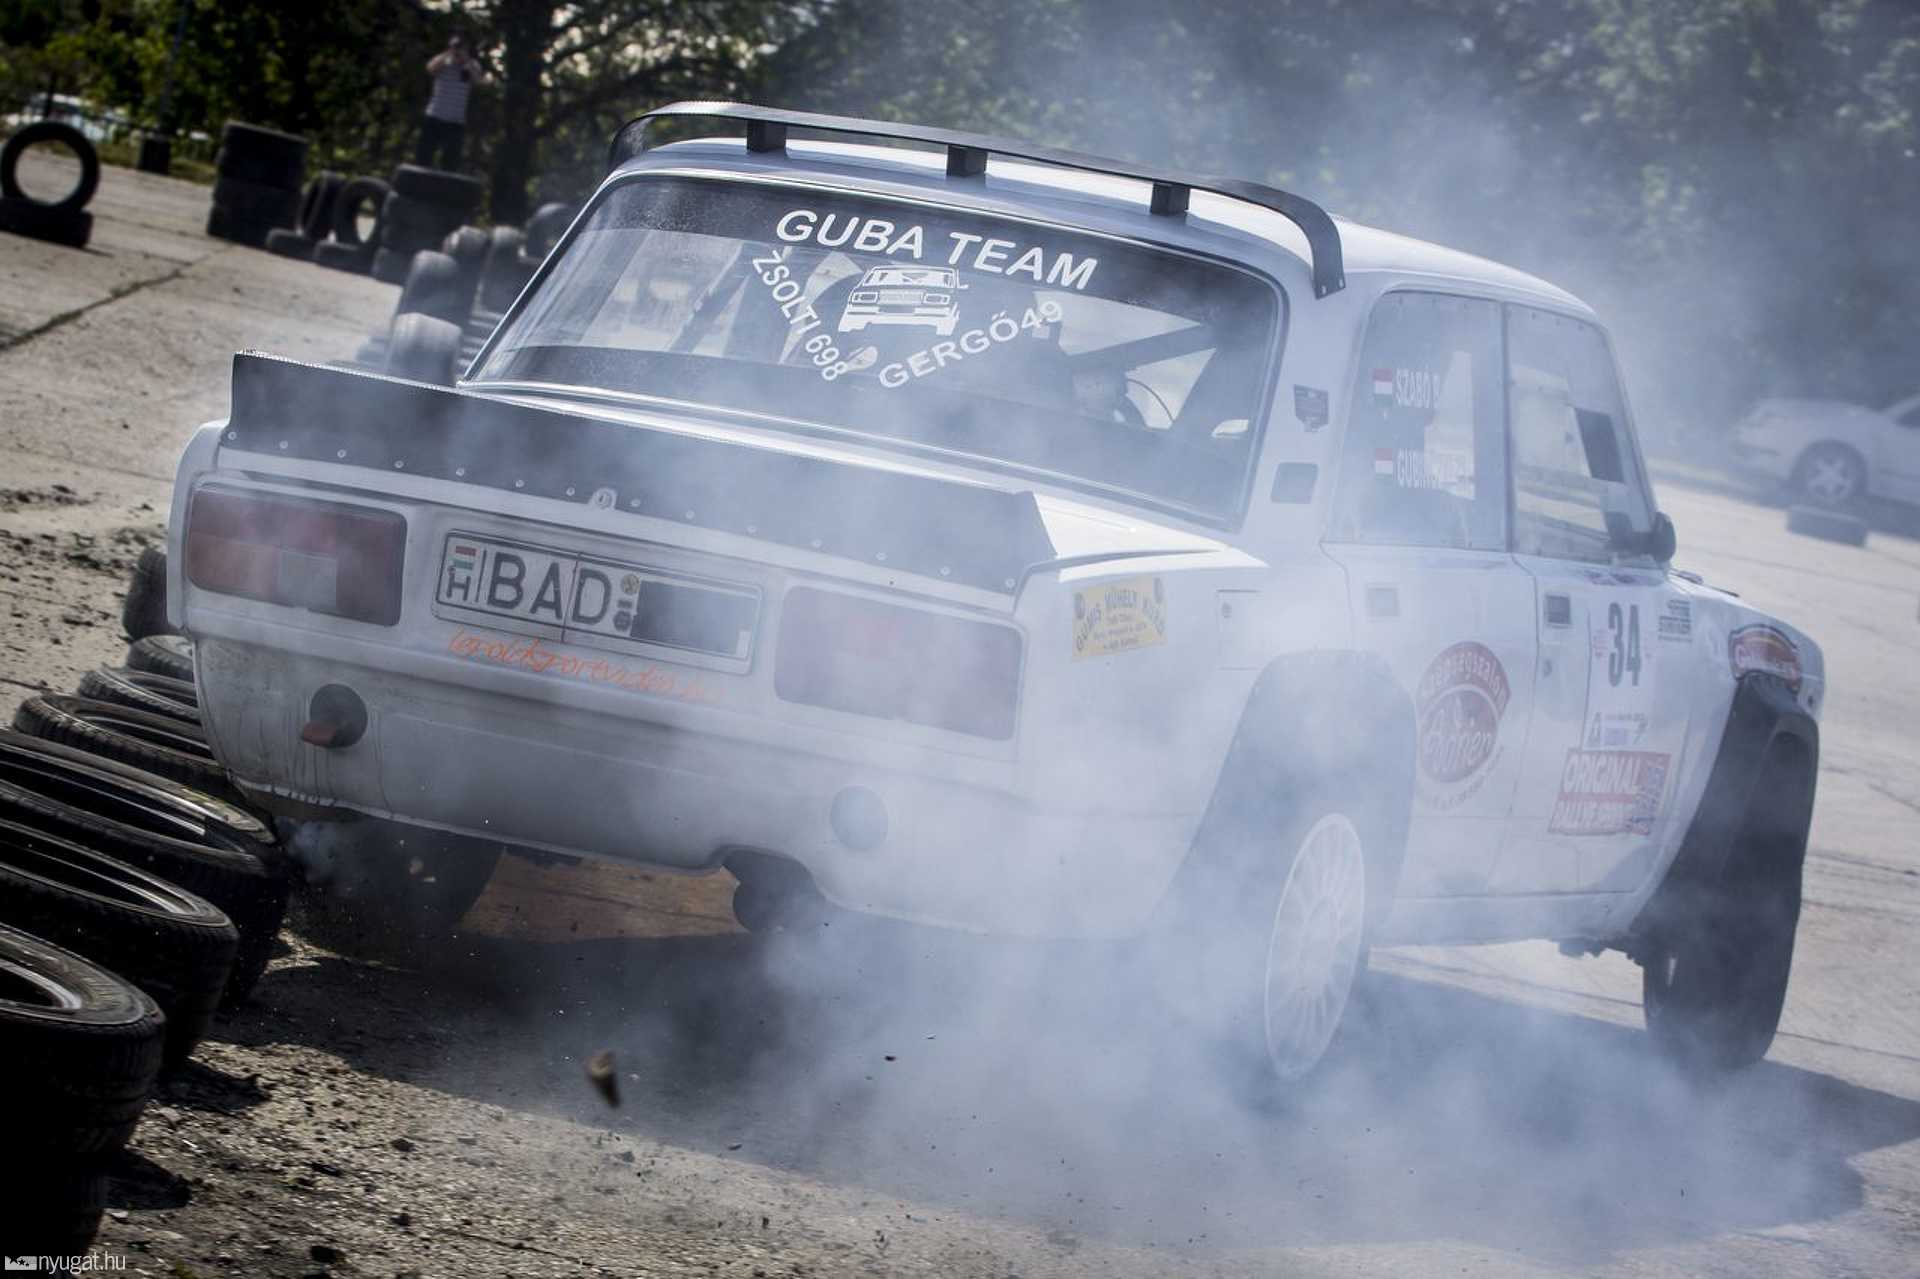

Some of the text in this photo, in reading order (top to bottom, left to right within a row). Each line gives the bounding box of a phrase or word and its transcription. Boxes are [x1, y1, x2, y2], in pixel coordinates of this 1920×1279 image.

[776, 209, 1098, 290] GUBA TEAM
[752, 249, 848, 382] ZSOLTI 698
[487, 551, 612, 625] BAD
[1608, 602, 1642, 687] 34
